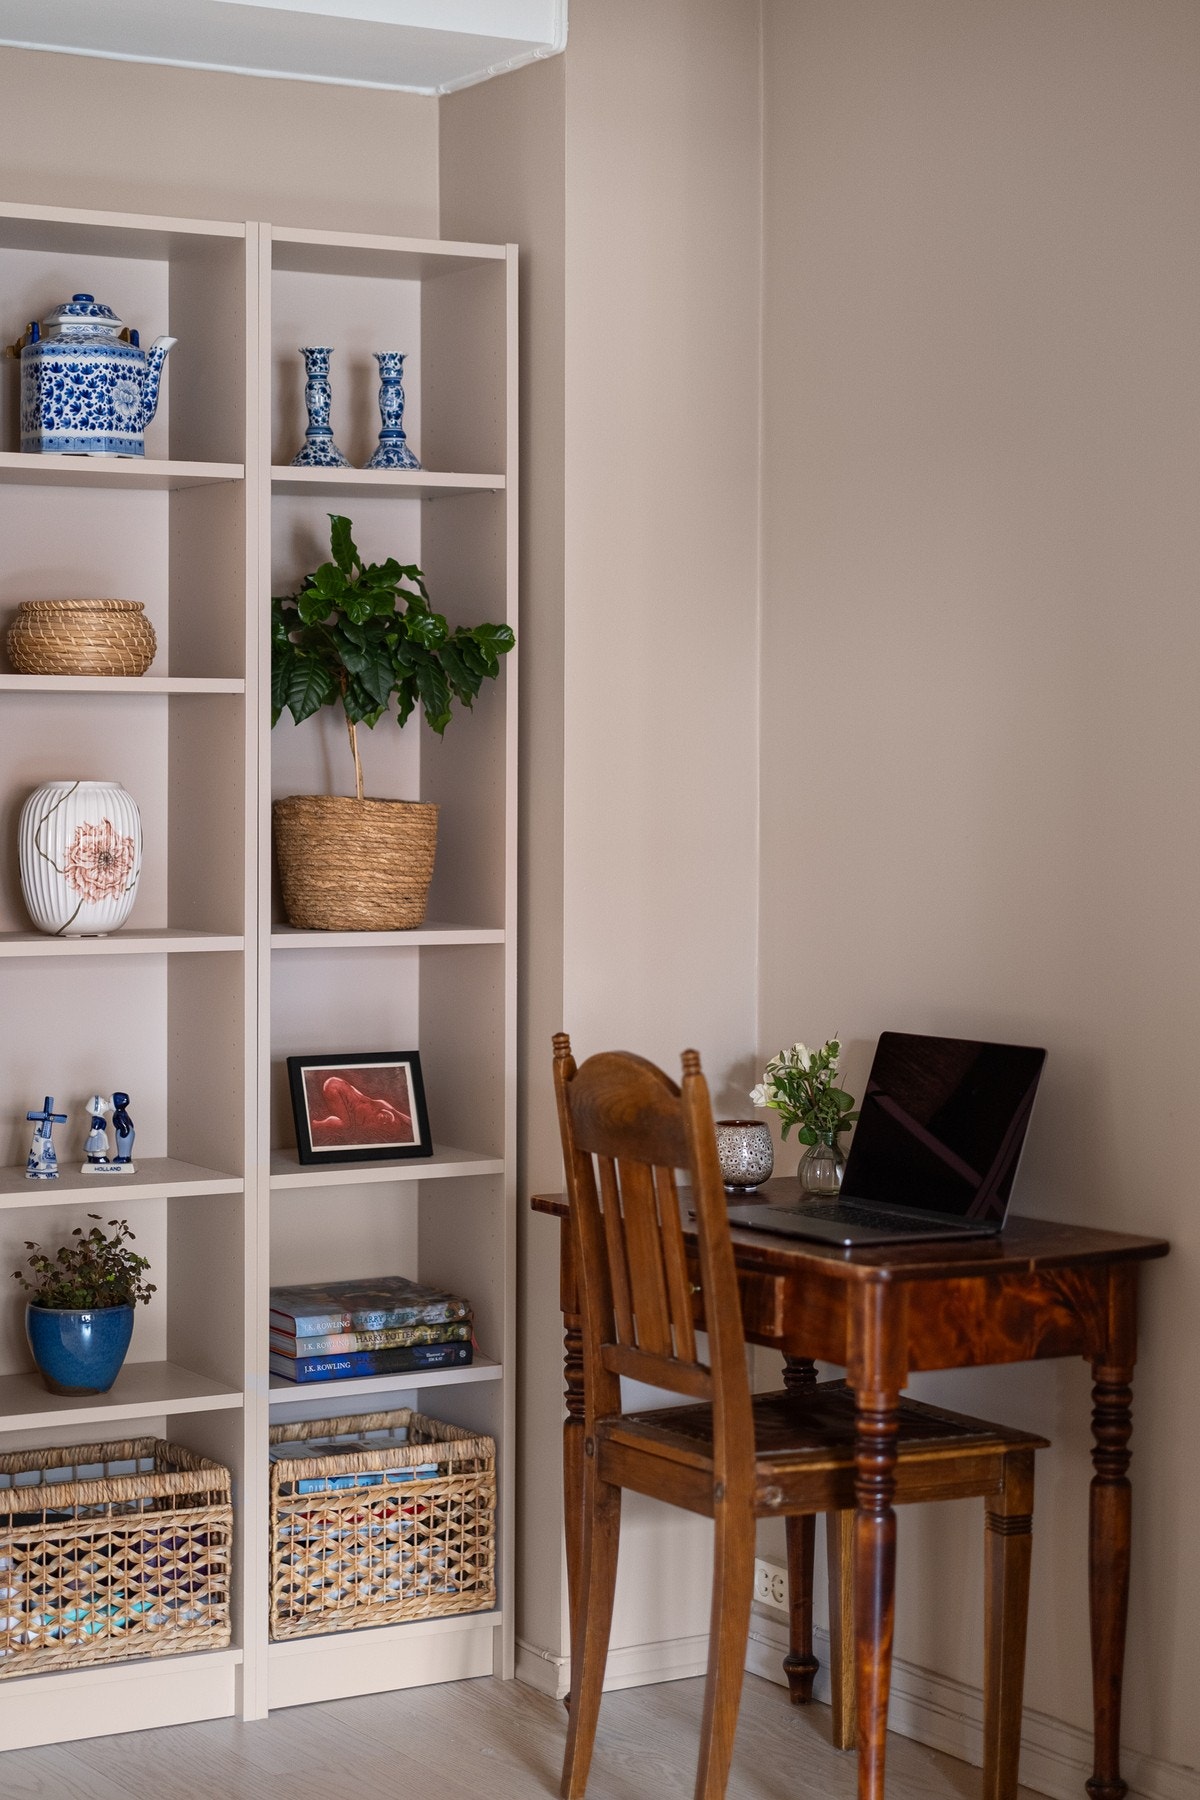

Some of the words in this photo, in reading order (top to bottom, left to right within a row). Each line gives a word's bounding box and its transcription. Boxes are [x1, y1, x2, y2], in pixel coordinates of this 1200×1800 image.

[356, 1314, 384, 1325] HARRY
[385, 1311, 416, 1321] POTTER
[316, 1320, 351, 1330] ROWLING
[355, 1333, 384, 1344] HARRY
[385, 1330, 416, 1341] POTTER
[303, 1343, 316, 1351] J.K.
[304, 1364, 316, 1373] J.K.
[316, 1361, 351, 1371] ROWLING
[308, 1484, 332, 1493] DAVD
